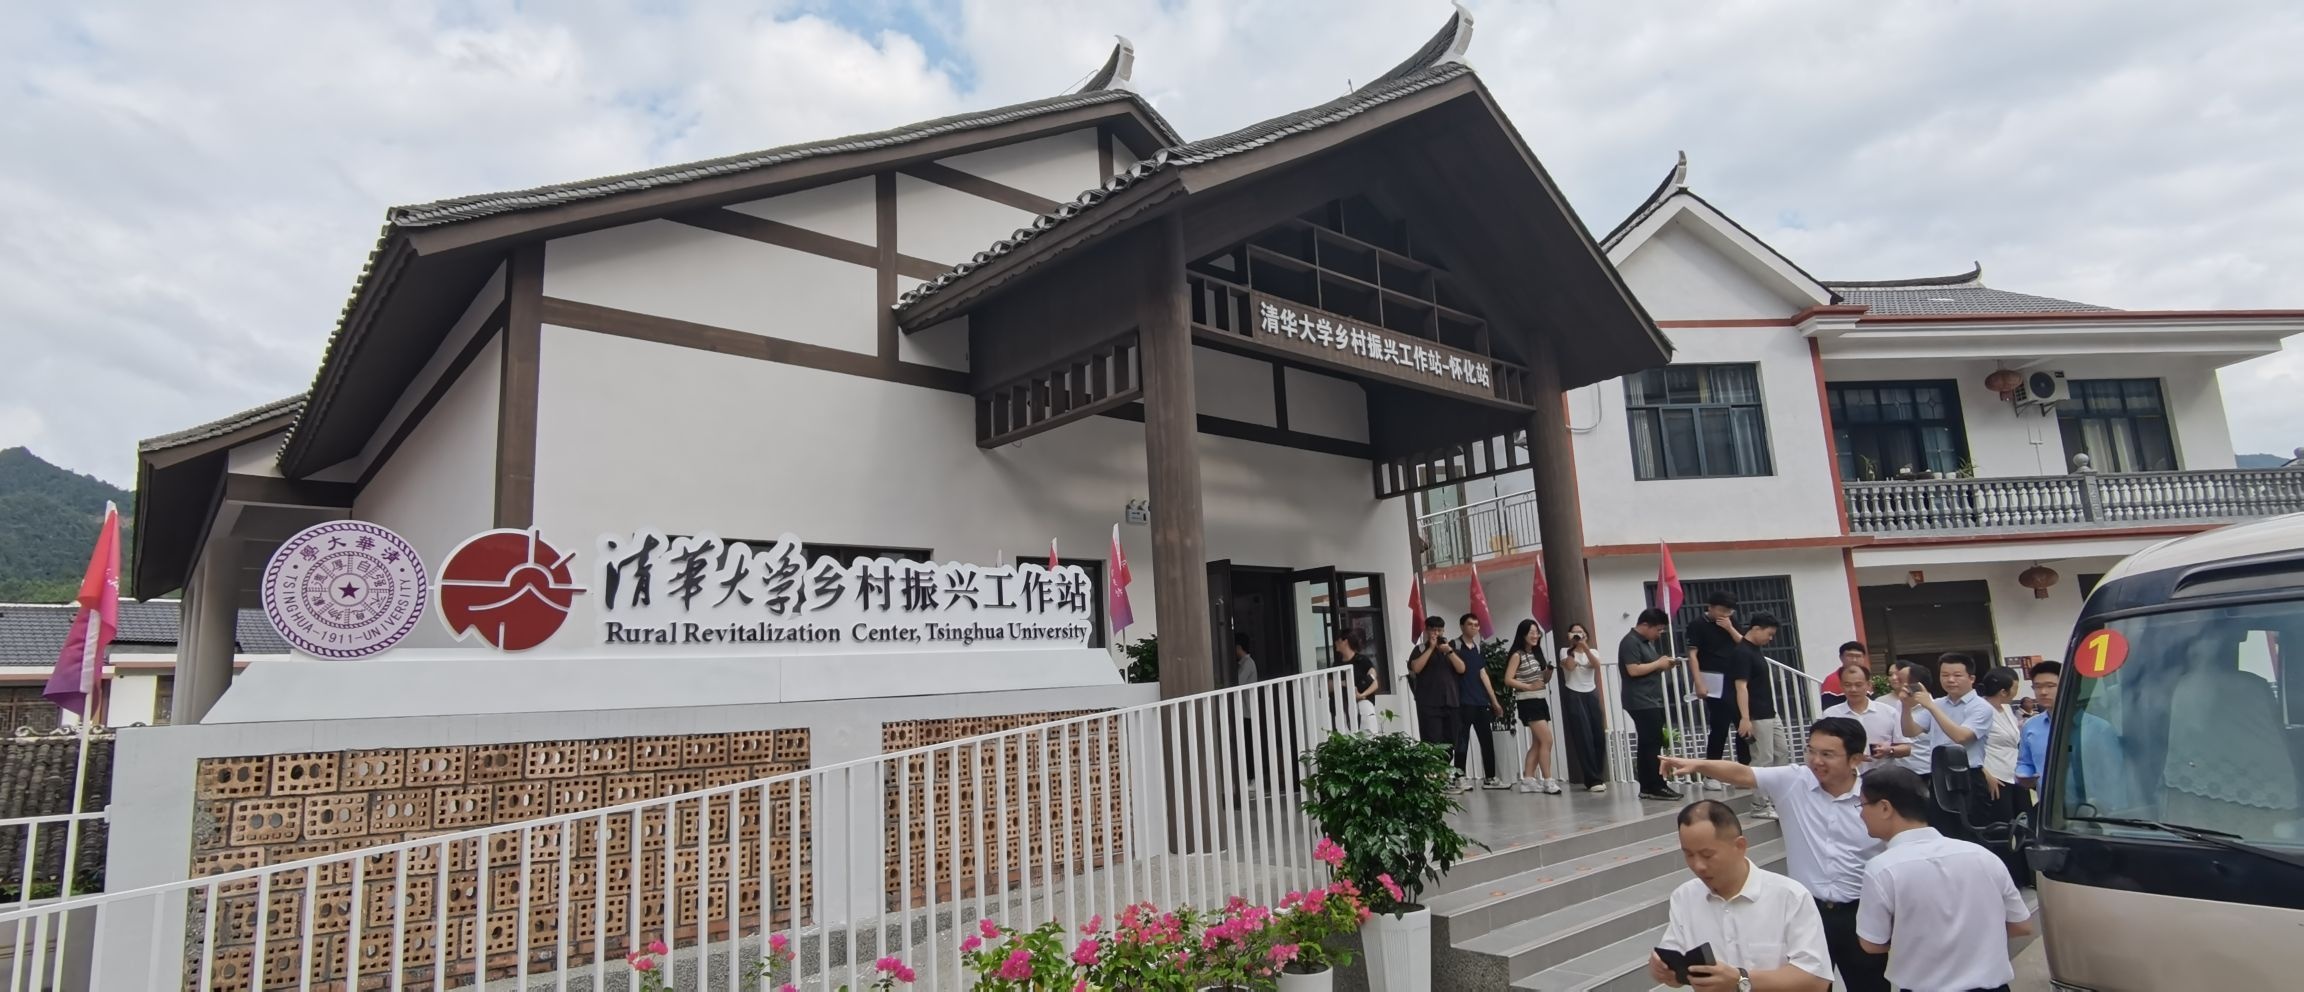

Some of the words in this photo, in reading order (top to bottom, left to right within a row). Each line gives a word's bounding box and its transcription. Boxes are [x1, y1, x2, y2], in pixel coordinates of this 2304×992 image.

[1260, 301, 1490, 388] 清华大学乡村振兴工作站-怀化站
[605, 621, 677, 643] Rural
[683, 621, 841, 643] Revitalization
[852, 622, 921, 643] Center,
[925, 622, 1005, 645] Tsinghua
[1008, 621, 1088, 643] University
[2089, 633, 2110, 672] 1
